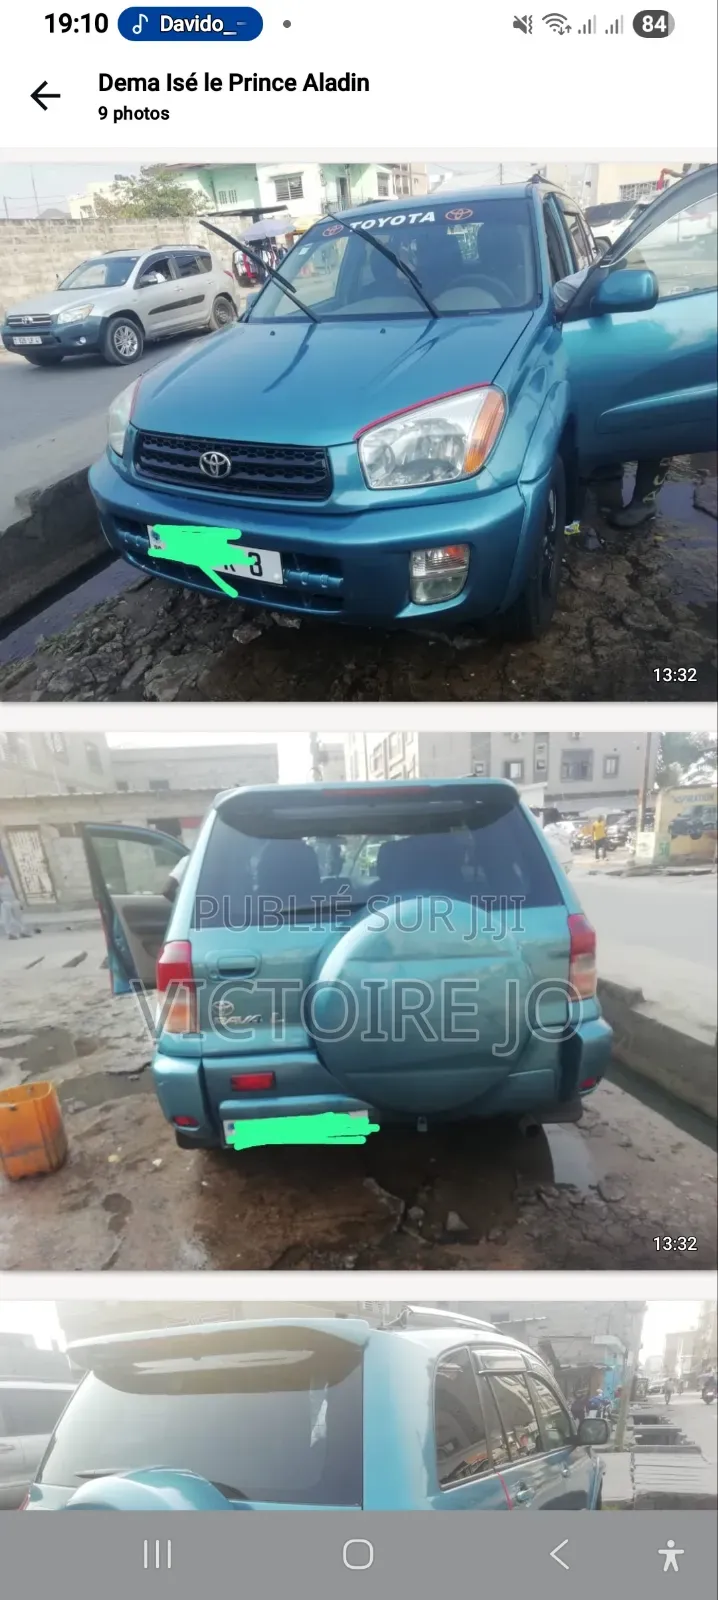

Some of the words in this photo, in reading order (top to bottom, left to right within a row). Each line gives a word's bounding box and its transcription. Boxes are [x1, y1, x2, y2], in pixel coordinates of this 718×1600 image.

[44, 13, 108, 33] 19:10
[642, 15, 667, 33] 84
[99, 73, 159, 92] Dema
[167, 72, 197, 92] Isé
[205, 72, 222, 92] le
[230, 73, 296, 92] Prince
[303, 72, 370, 92] Aladin
[98, 106, 108, 120] 9
[114, 106, 170, 124] photos
[349, 211, 435, 232] TOYOTA
